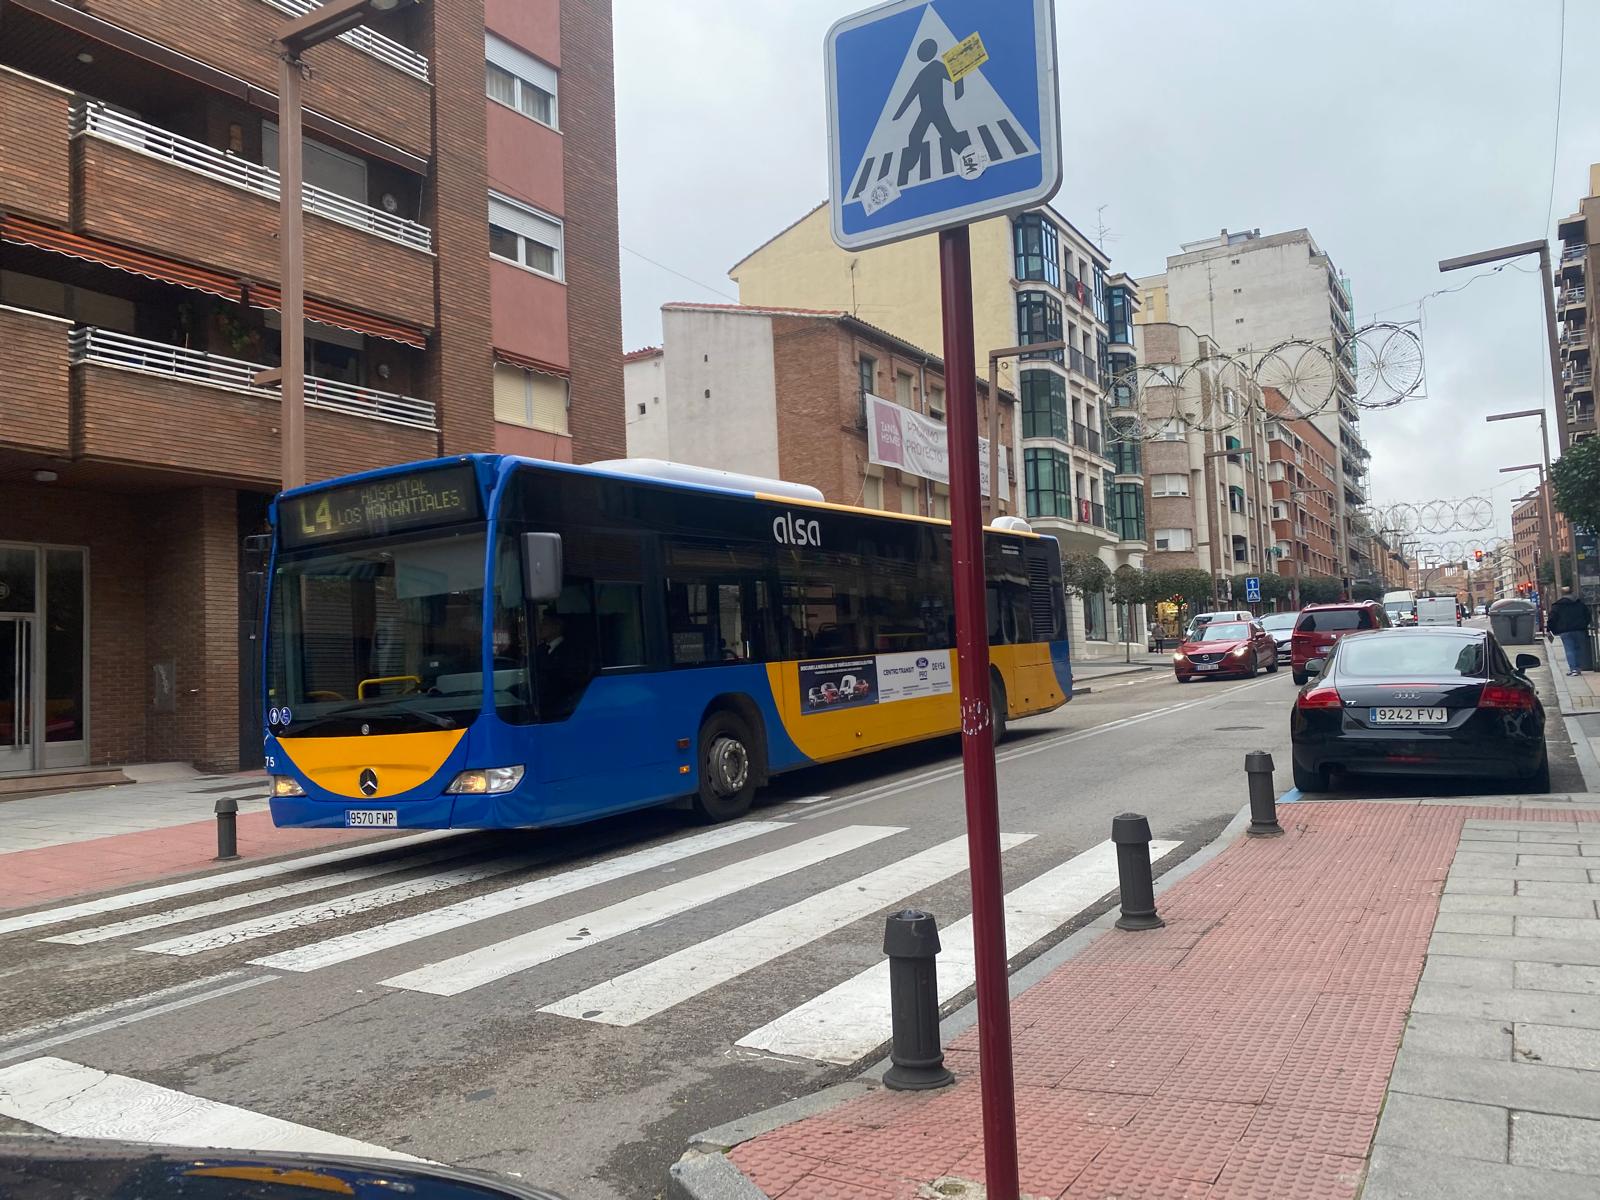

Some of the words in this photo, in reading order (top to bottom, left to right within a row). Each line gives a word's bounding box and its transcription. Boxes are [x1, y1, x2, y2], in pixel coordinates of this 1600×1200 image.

[361, 479, 428, 505] HOSPITAL
[299, 497, 332, 534] L4
[338, 507, 362, 526] LOS
[365, 490, 460, 520] MANANTIALES
[773, 511, 821, 547] alsa
[1379, 709, 1413, 720] 9242
[1417, 709, 1444, 720] FVJ
[351, 812, 373, 825] 9570
[376, 812, 394, 825] FMP
